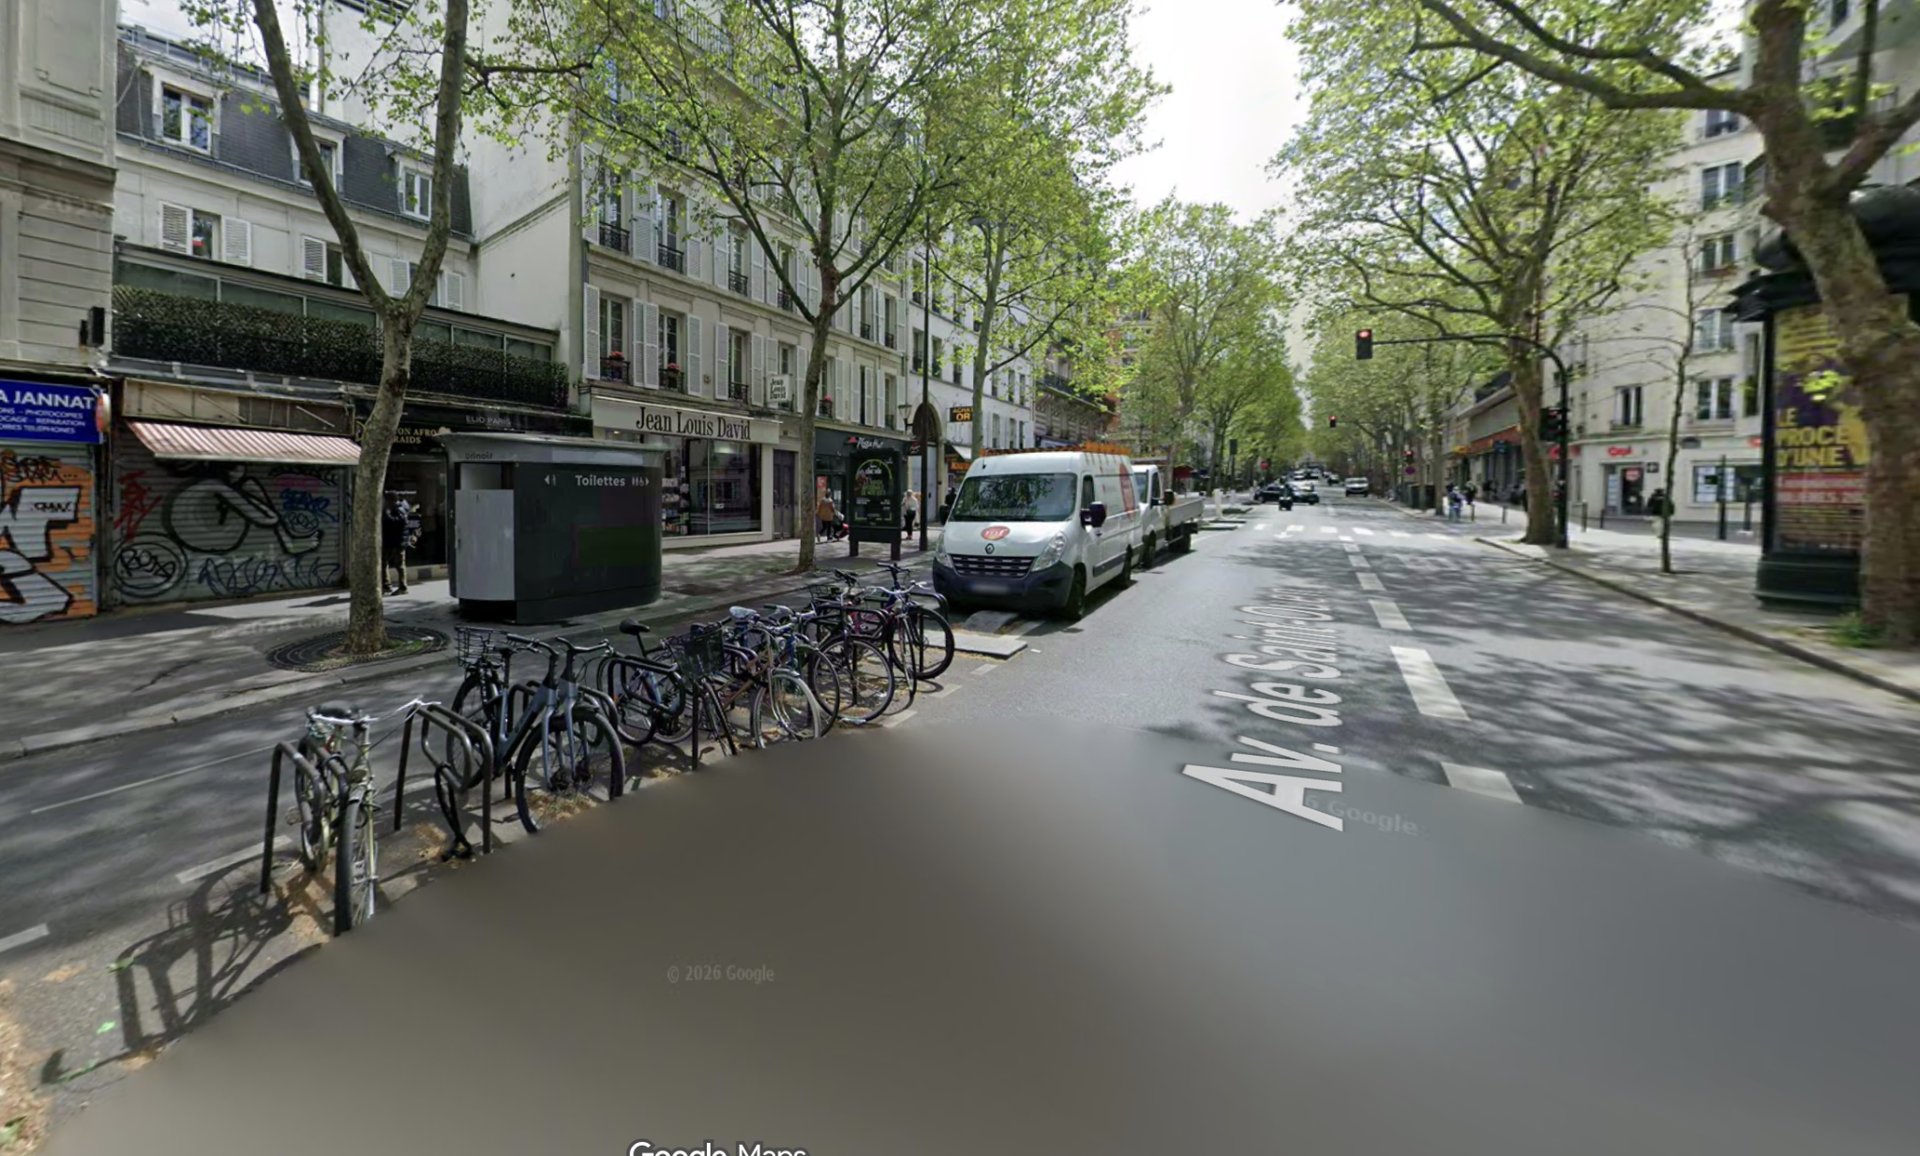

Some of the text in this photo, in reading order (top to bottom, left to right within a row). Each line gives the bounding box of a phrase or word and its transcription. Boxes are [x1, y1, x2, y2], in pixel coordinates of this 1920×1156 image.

[13, 391, 94, 410] JANNAT
[636, 407, 751, 441] Jean Louis David
[956, 412, 971, 421] OR
[1776, 407, 1798, 427] LE
[575, 474, 626, 487] Toilettes
